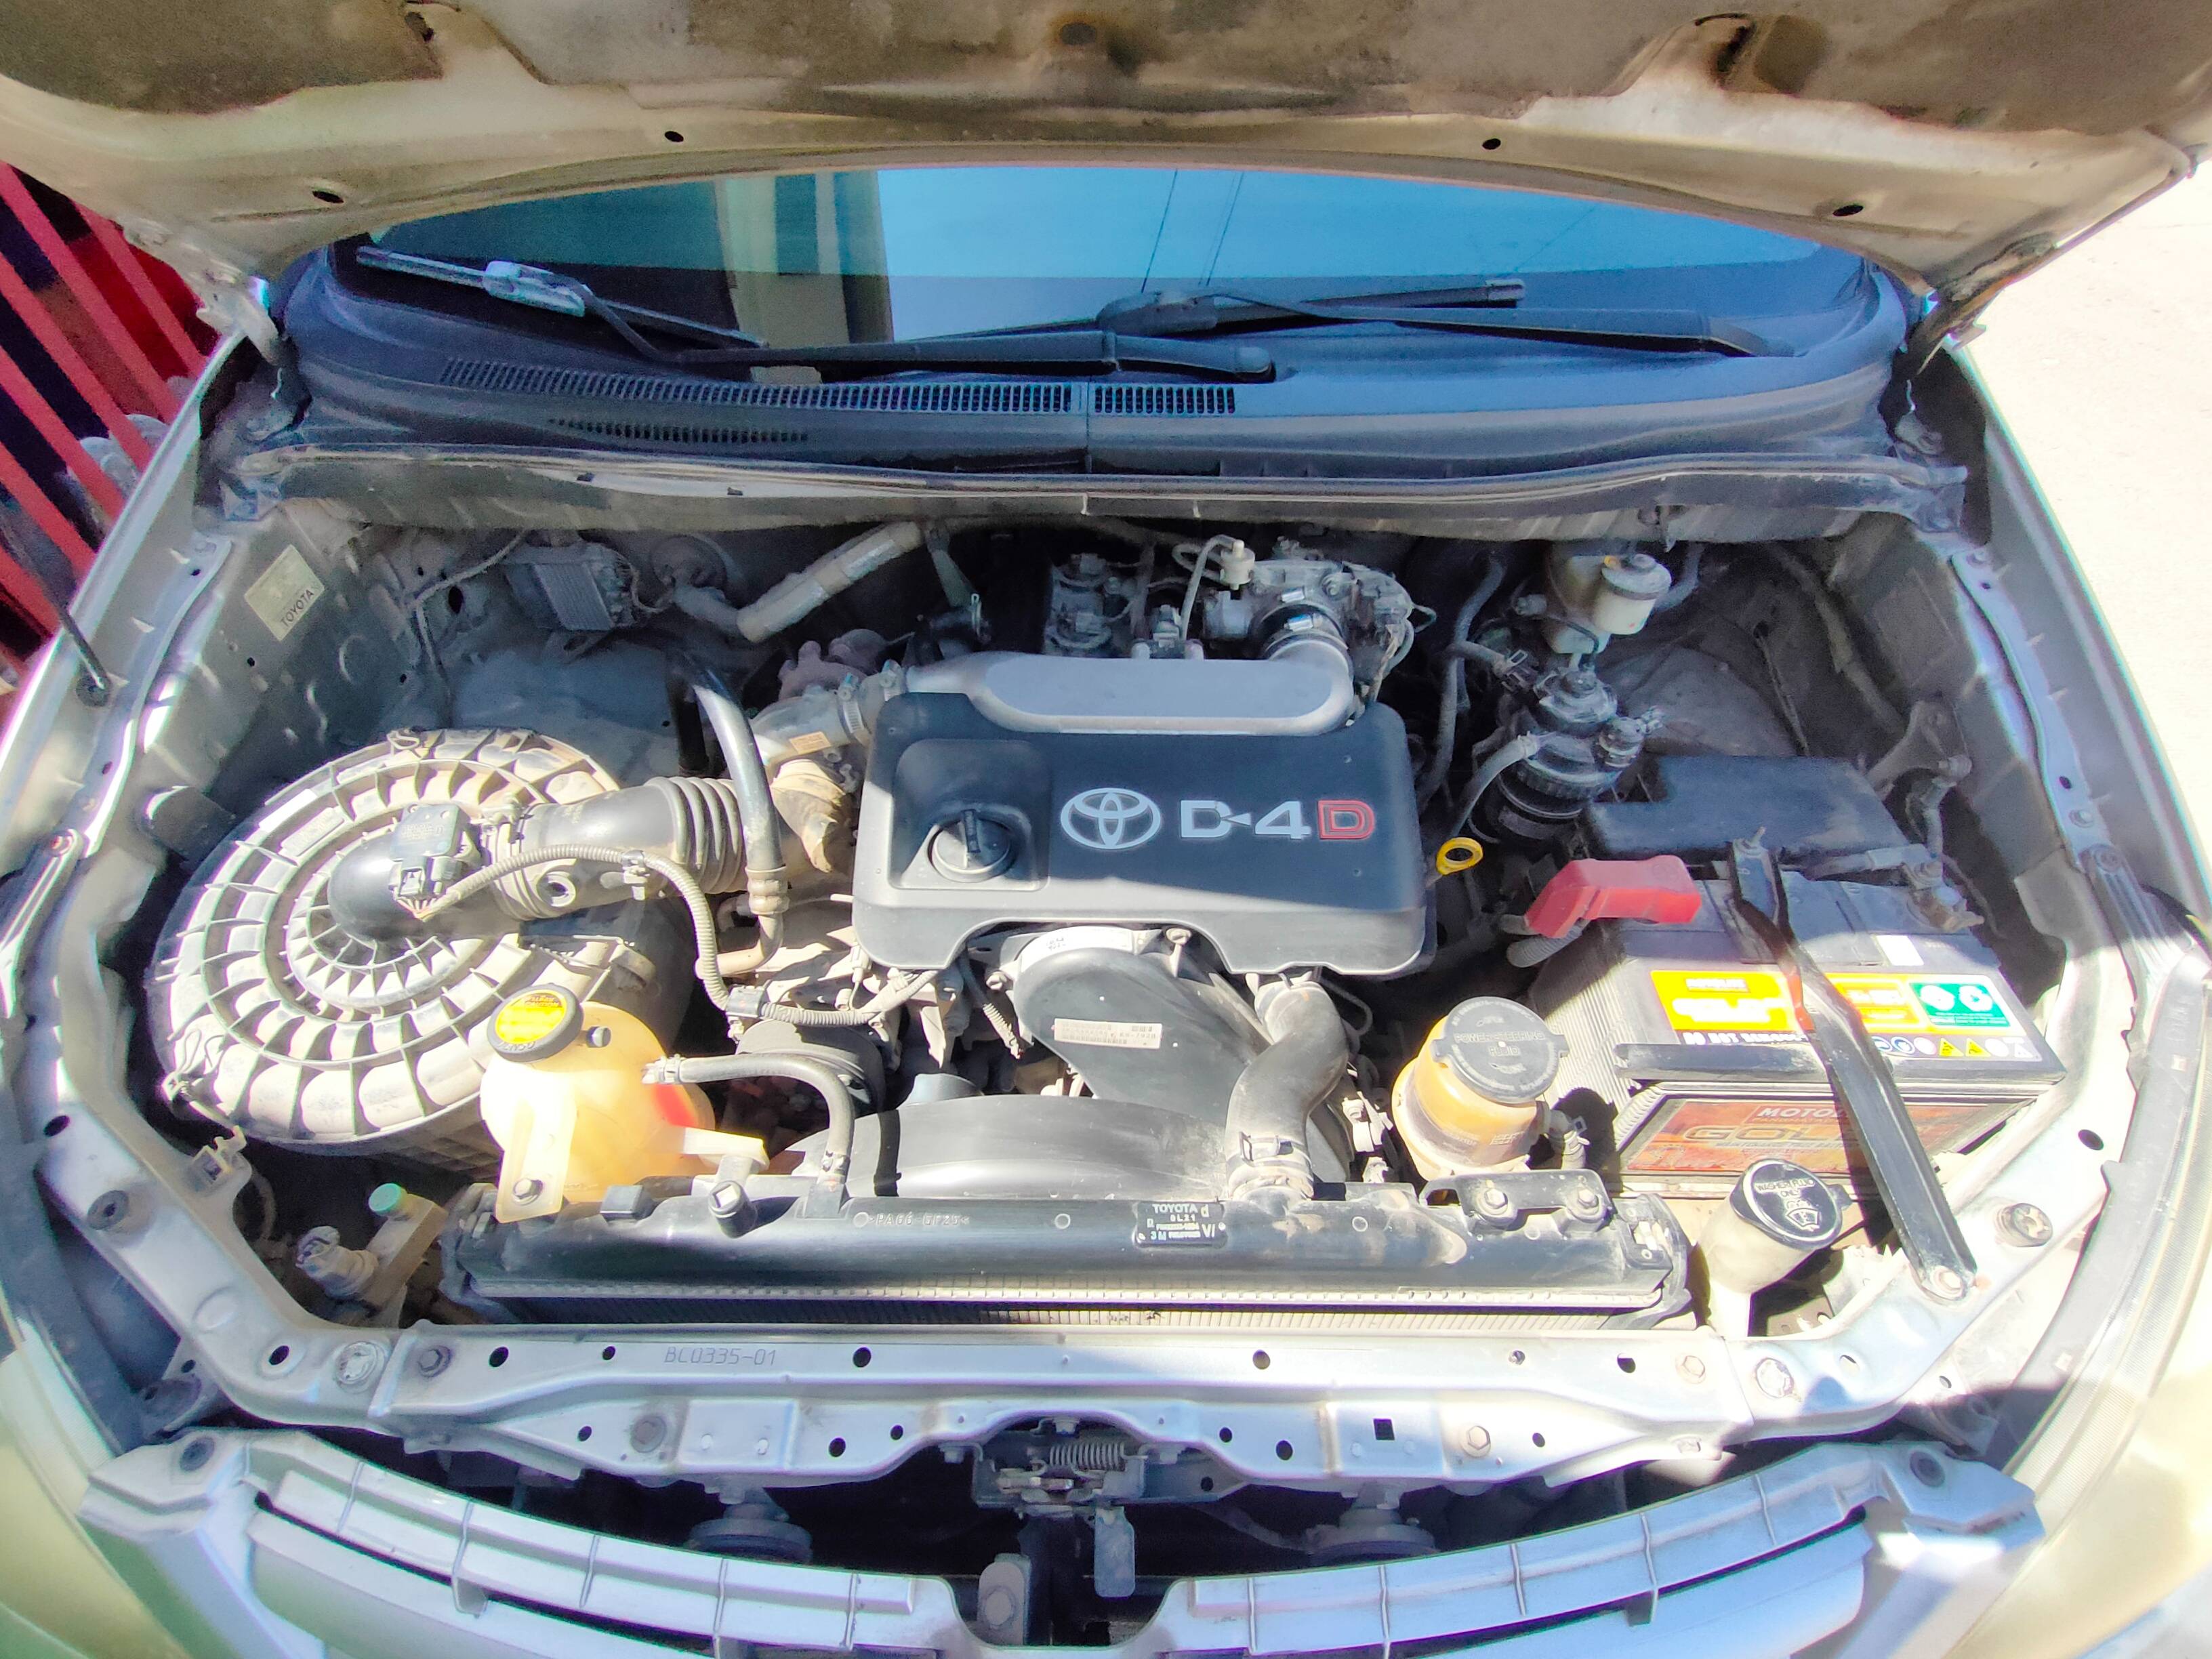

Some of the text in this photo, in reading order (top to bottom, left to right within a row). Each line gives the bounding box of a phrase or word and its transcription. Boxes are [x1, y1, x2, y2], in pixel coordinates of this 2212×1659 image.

[279, 588, 315, 628] TOYOTA
[1454, 1030, 1547, 1044] POWER STEERING
[1488, 1046, 1521, 1057] FLUID
[1756, 1181, 1789, 1191] WASHER
[1152, 1204, 1198, 1214] TOYOTA
[663, 1346, 777, 1366] BC0335-01
